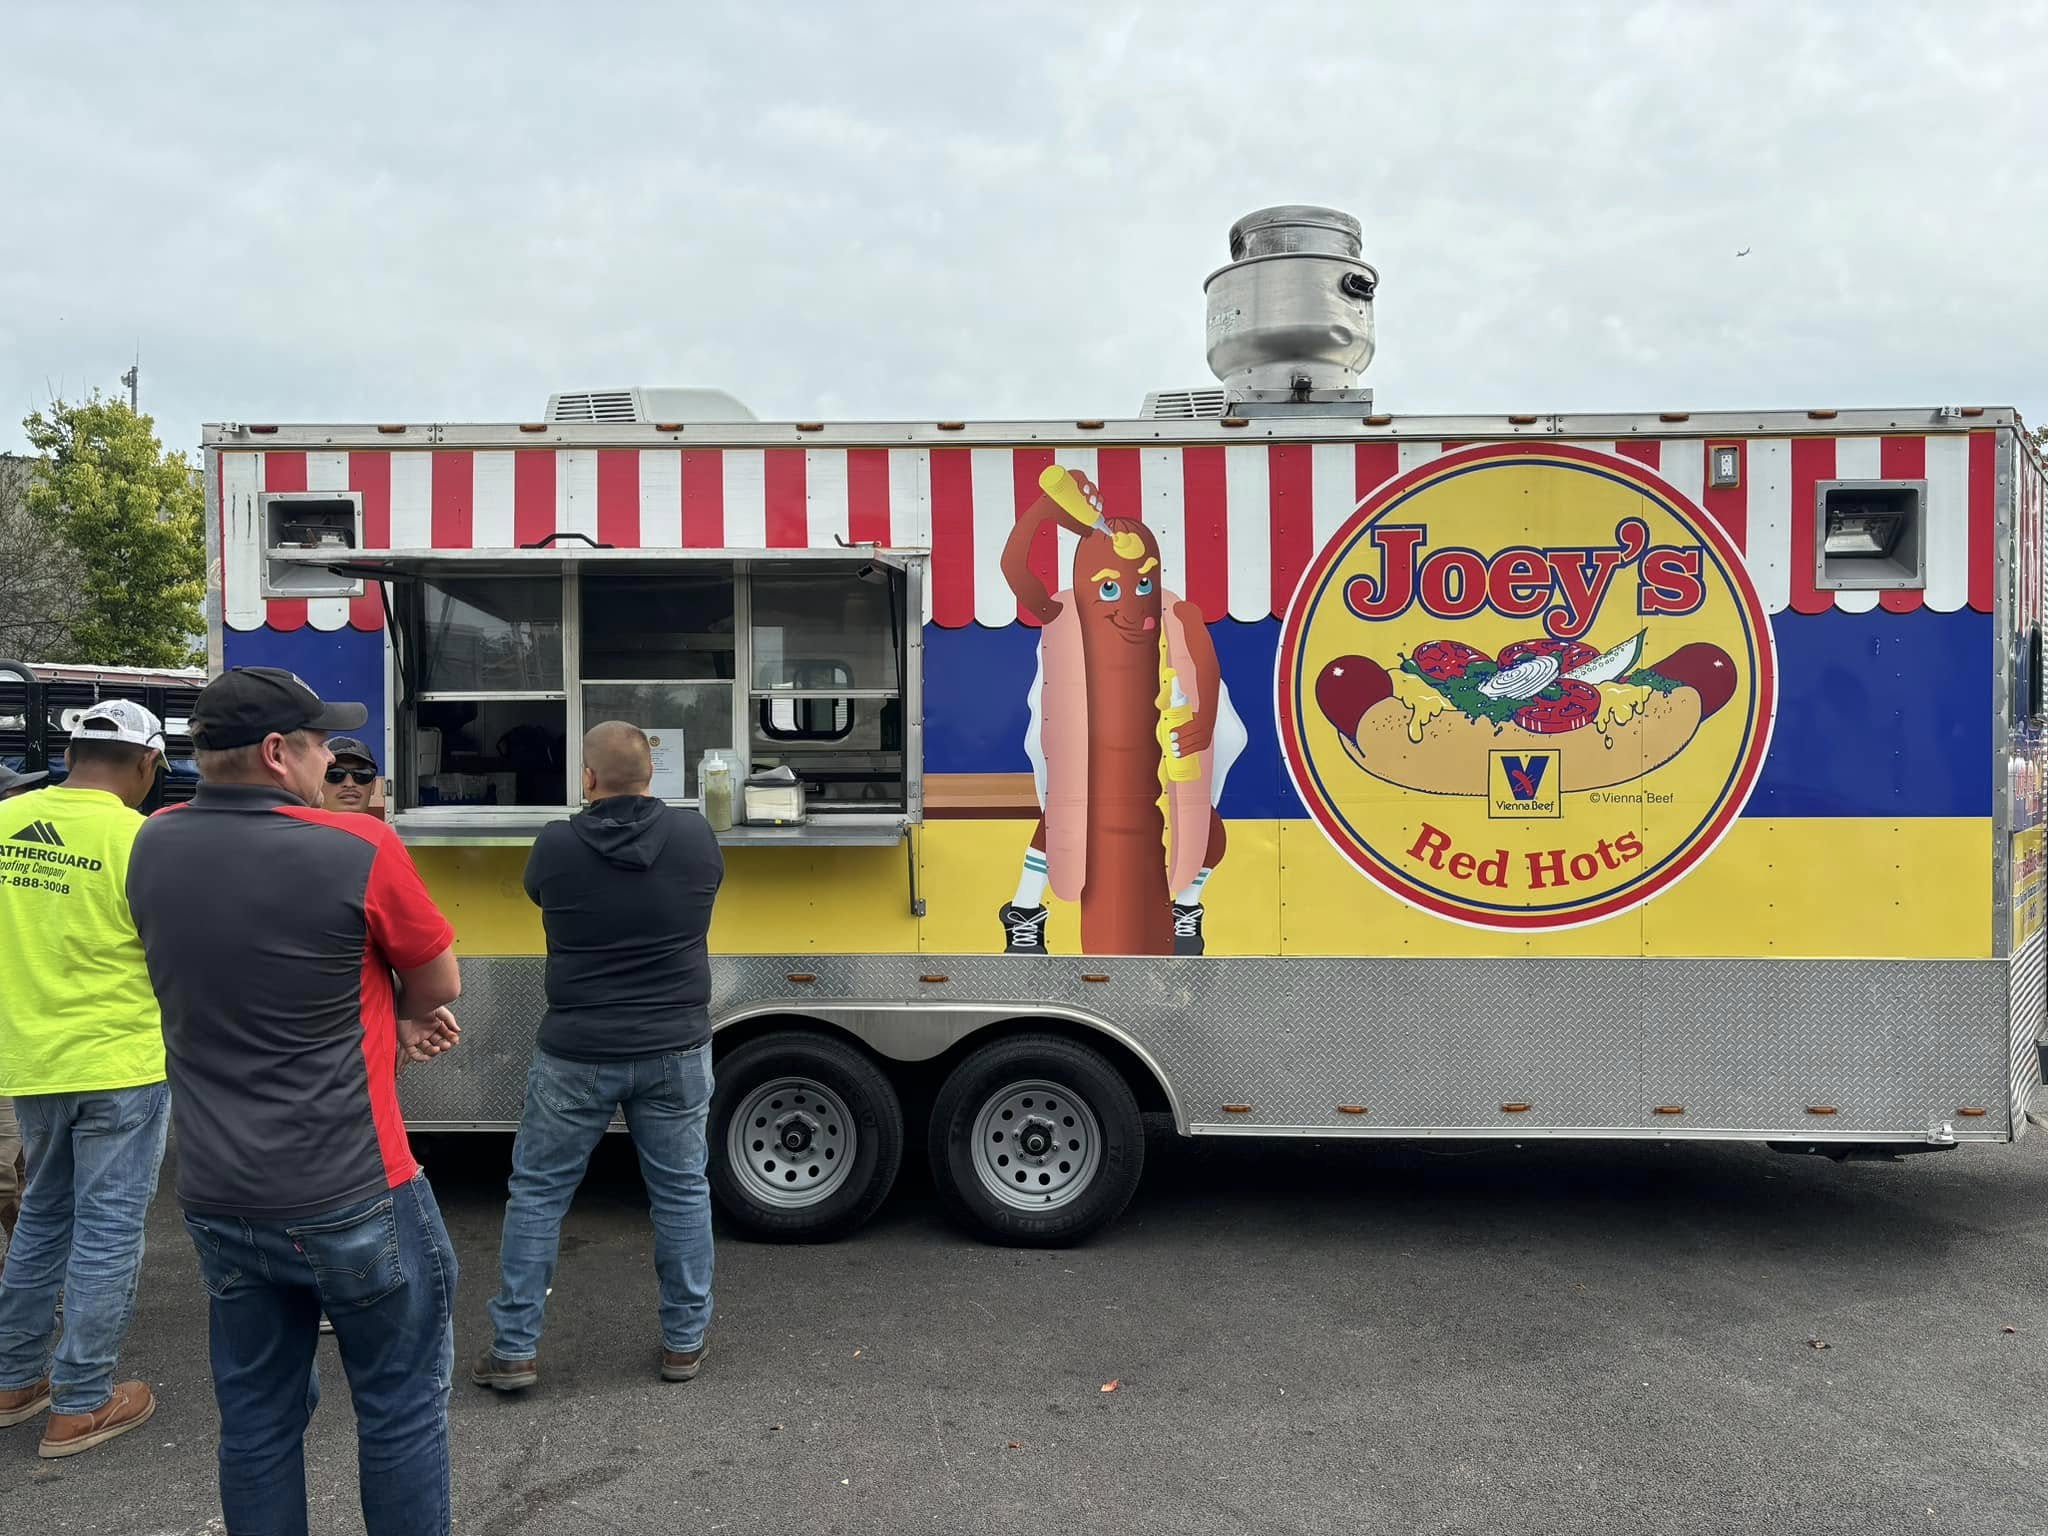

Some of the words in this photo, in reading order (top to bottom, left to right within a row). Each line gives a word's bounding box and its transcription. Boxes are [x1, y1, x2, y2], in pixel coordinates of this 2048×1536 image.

[1343, 517, 1706, 640] Joey's
[1496, 800, 1529, 811] Vienna
[1531, 800, 1554, 813] Beef
[1647, 793, 1674, 804] Beef
[1406, 822, 1509, 888] Red
[1525, 831, 1643, 889] Hots
[32, 861, 67, 880] Company
